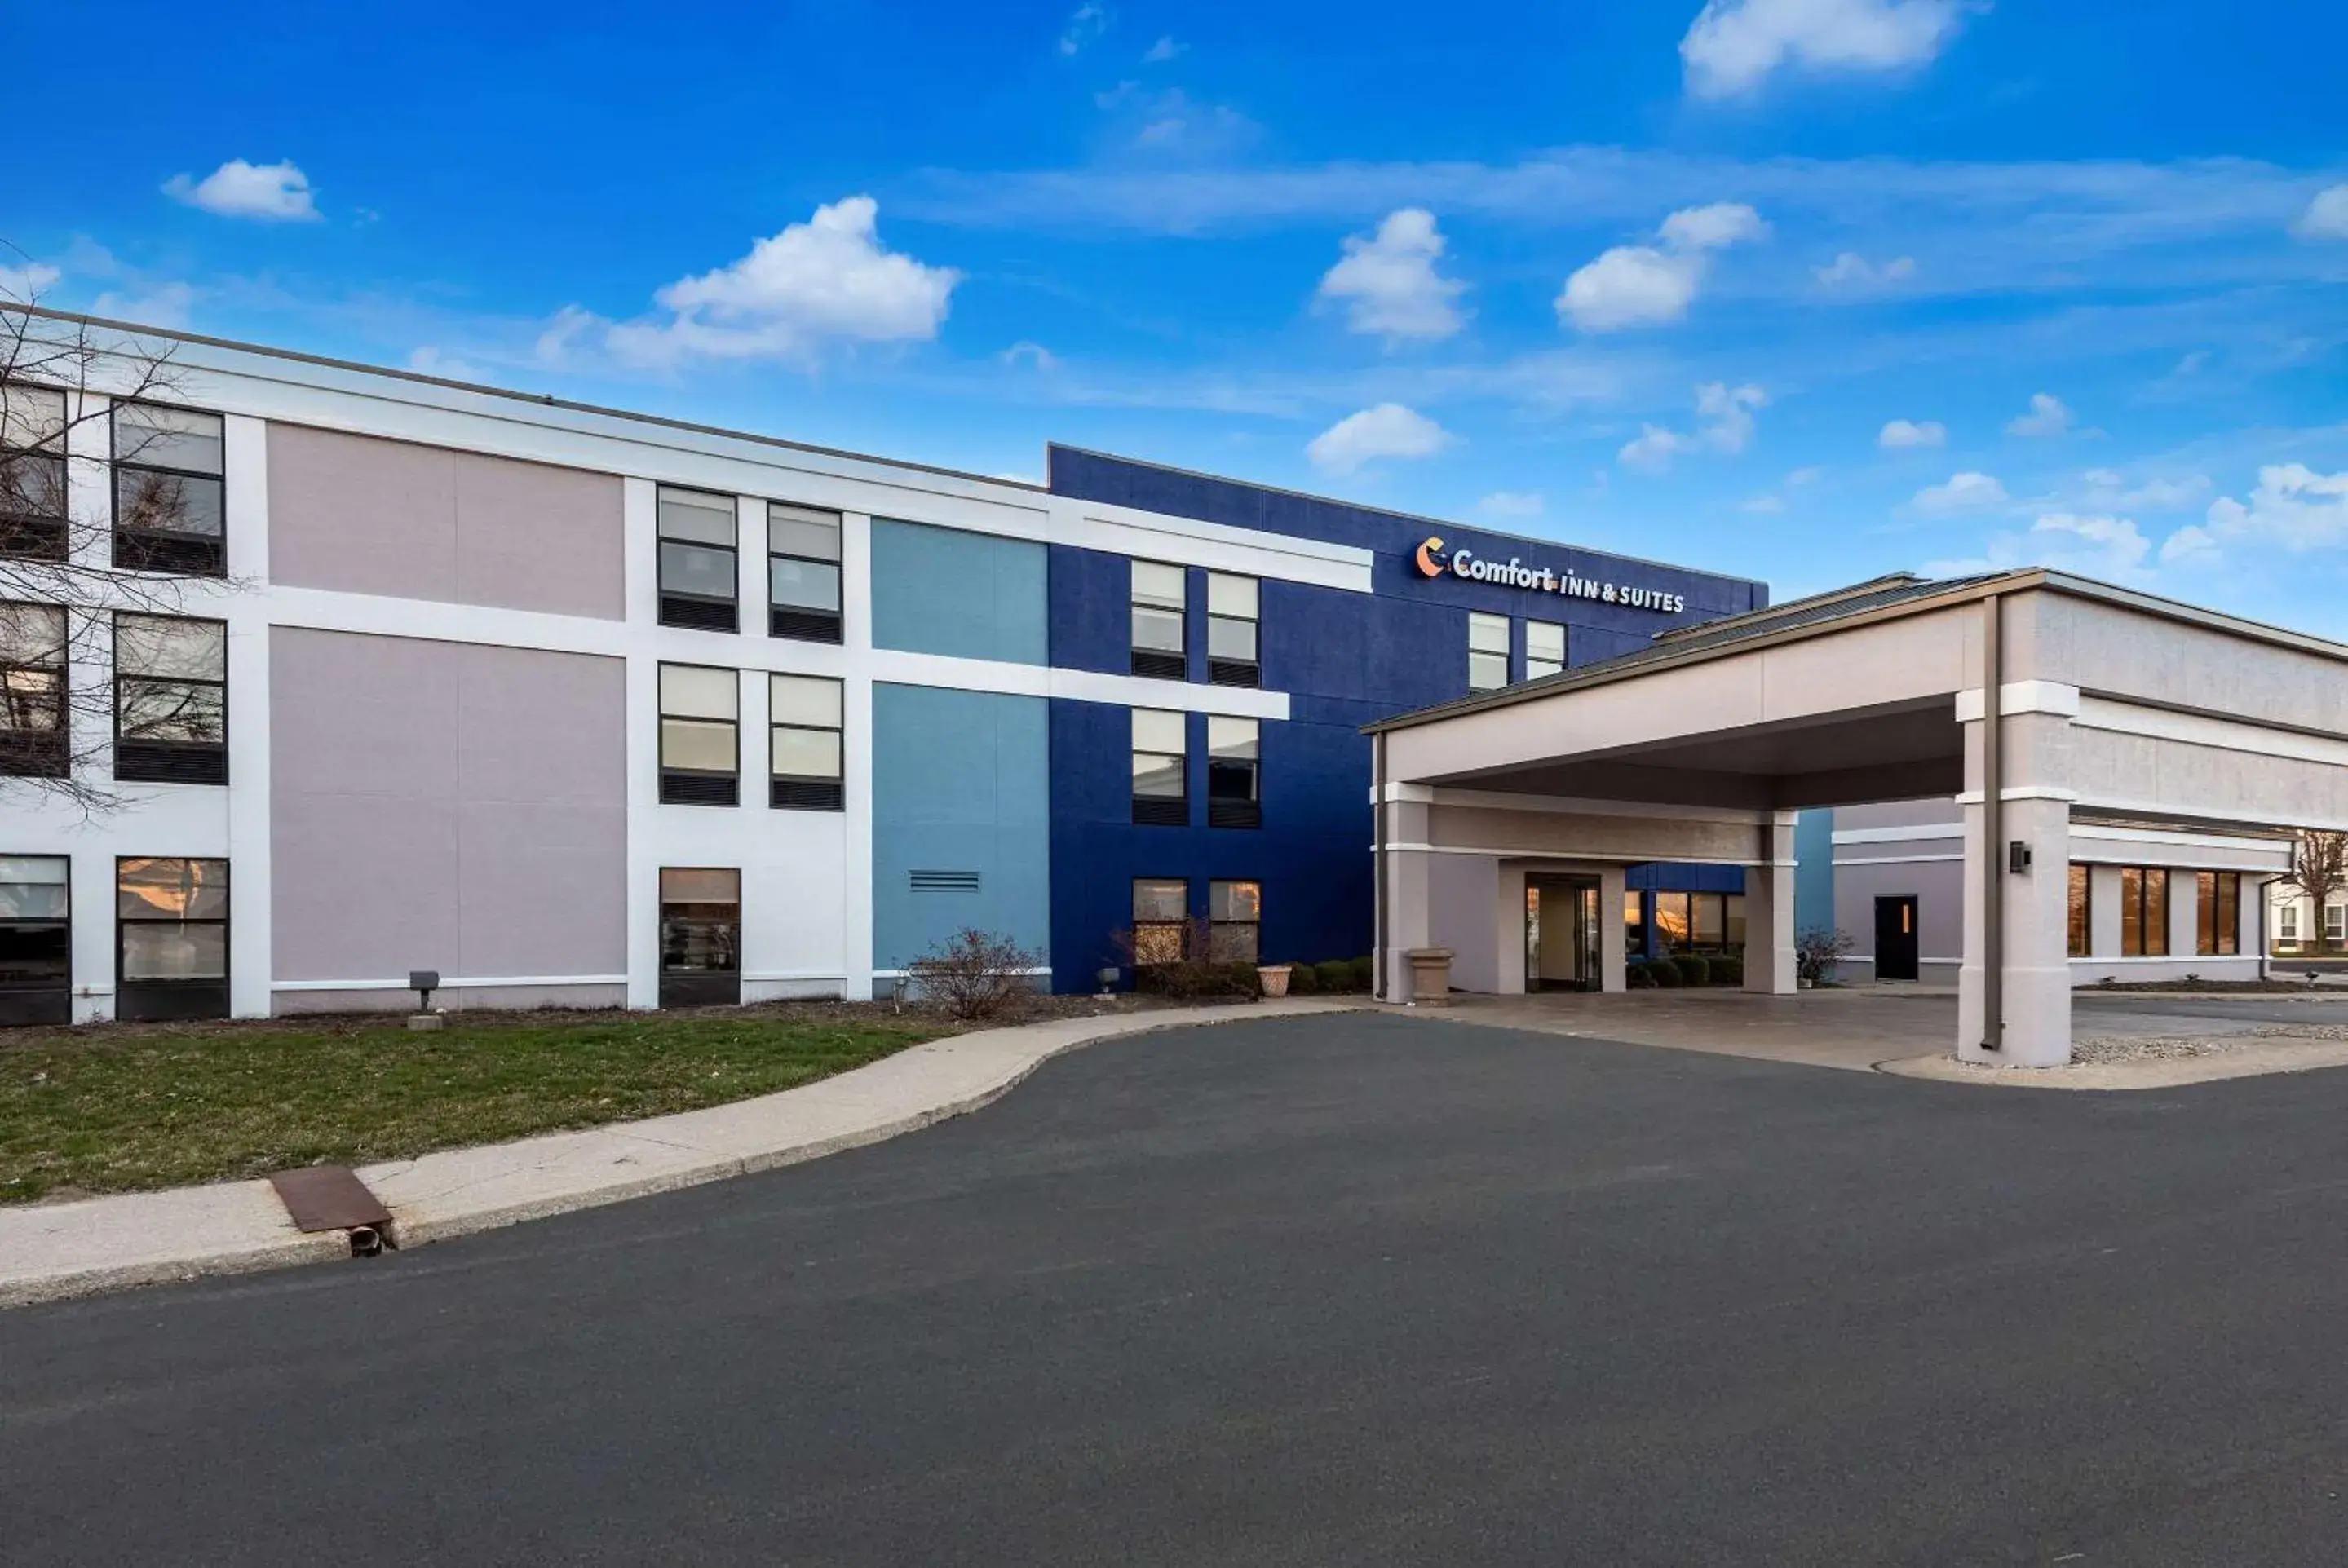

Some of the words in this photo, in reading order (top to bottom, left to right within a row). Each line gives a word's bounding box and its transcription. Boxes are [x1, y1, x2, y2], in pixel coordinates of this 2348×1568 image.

[1453, 550, 1554, 590] Comfort
[1602, 583, 1616, 603] &
[1620, 586, 1684, 612] SUITES
